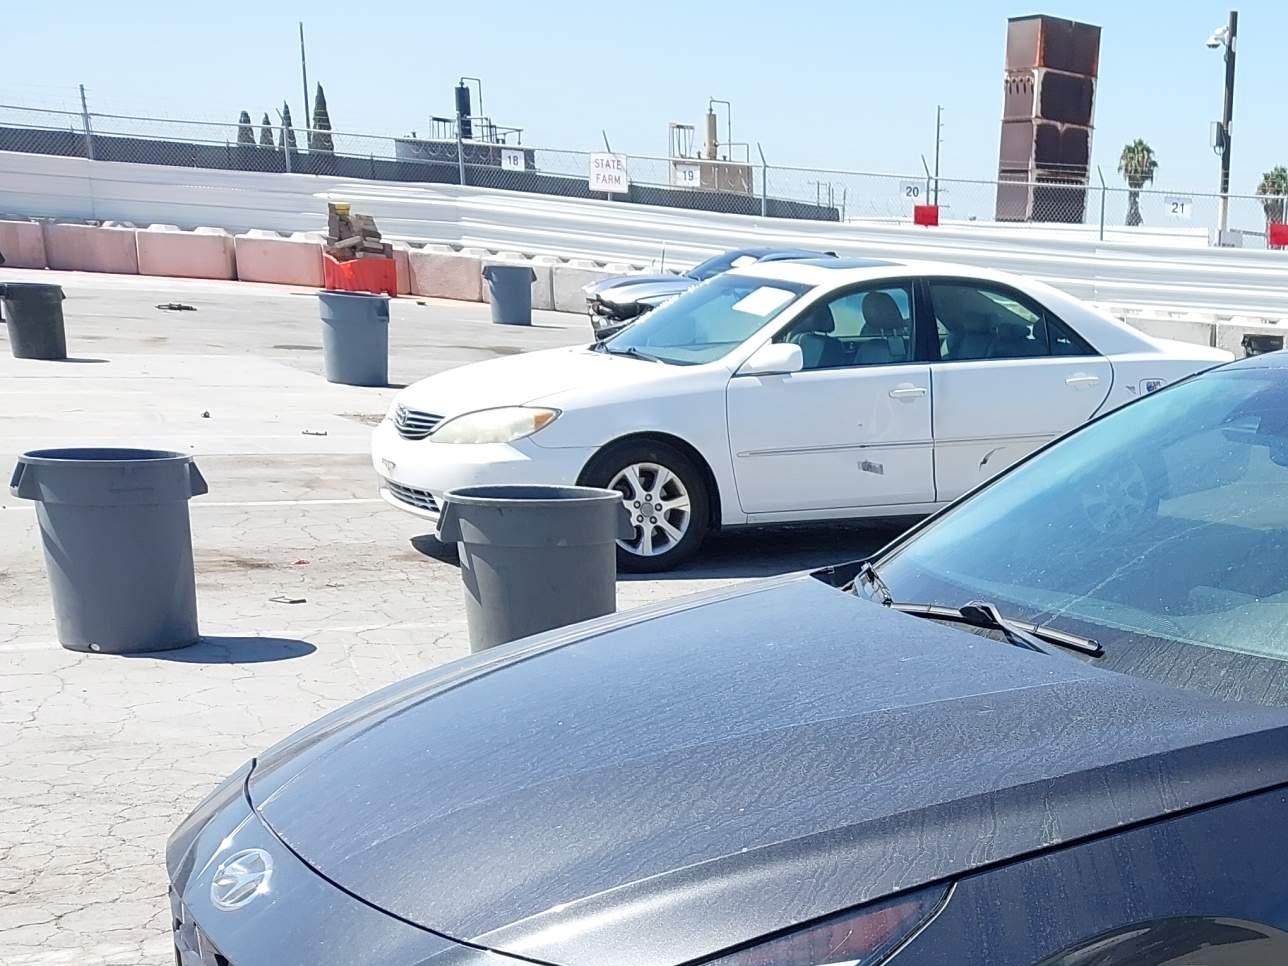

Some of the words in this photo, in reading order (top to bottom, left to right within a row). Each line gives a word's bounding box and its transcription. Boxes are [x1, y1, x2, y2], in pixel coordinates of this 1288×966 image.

[594, 158, 622, 171] STATE
[595, 173, 621, 185] FARM
[682, 170, 694, 182] 19
[905, 186, 920, 198] 20
[1171, 201, 1185, 214] 21
